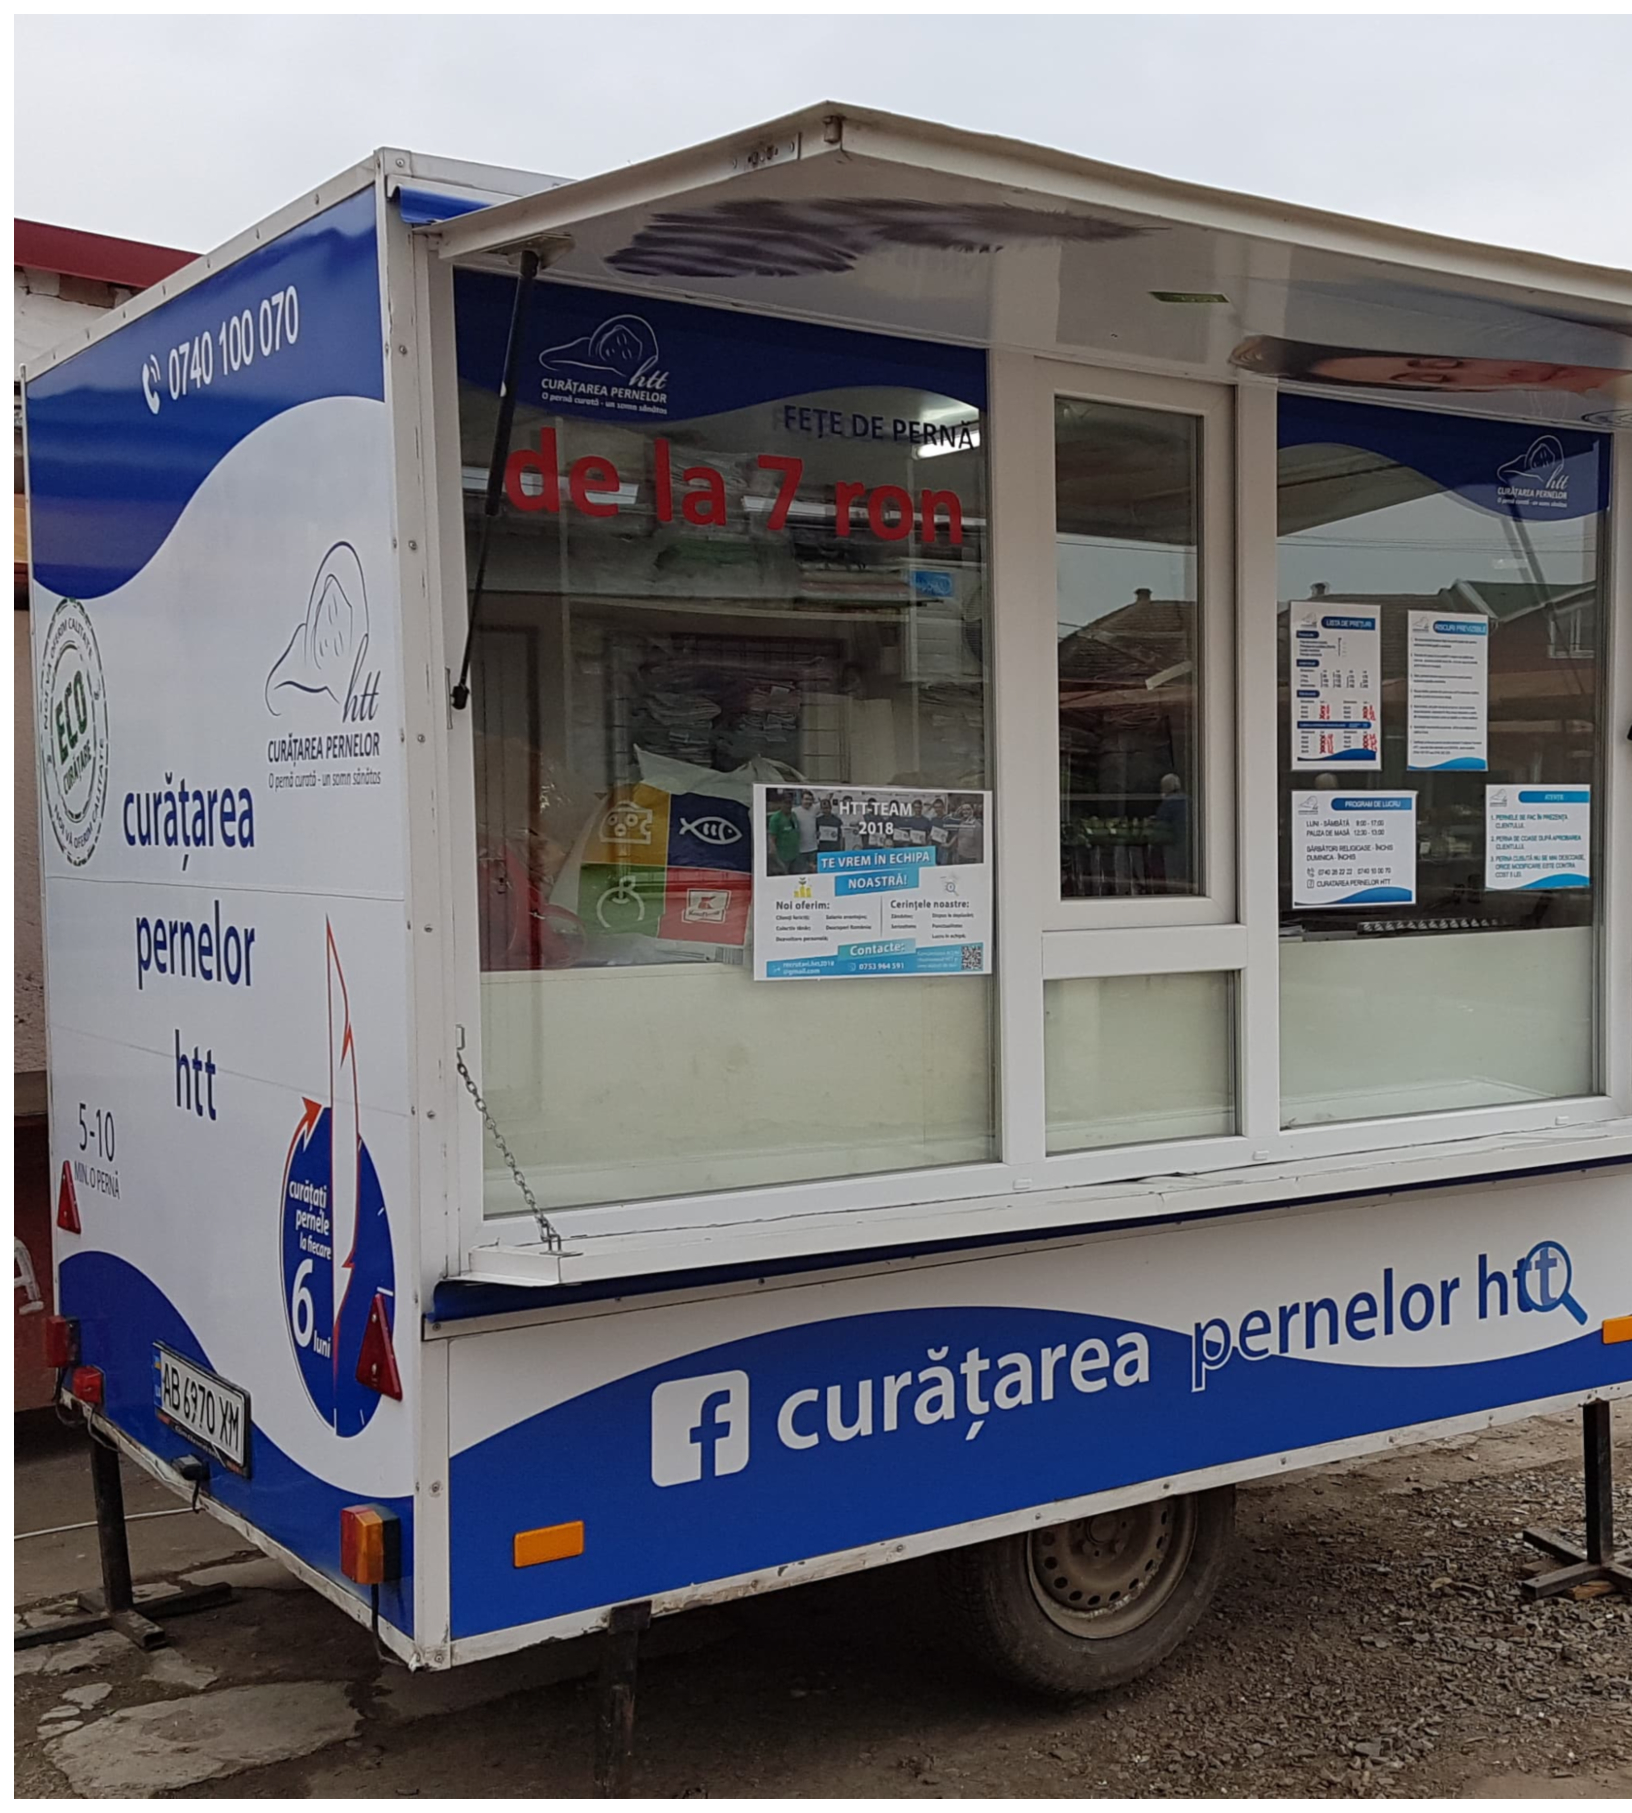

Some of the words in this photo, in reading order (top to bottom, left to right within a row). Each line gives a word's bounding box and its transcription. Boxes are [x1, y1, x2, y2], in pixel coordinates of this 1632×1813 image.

[168, 330, 213, 400] 0740
[219, 309, 254, 376] 100
[259, 285, 299, 357] 070
[629, 357, 670, 390] htt
[541, 377, 608, 397] CURĂȚAREA
[610, 387, 667, 404] PERNELOR
[784, 404, 844, 439] FEȚE
[854, 415, 883, 439] DE
[893, 417, 976, 451] PERNĂ
[504, 426, 621, 518] de
[654, 436, 727, 527] la
[756, 453, 804, 532] 7
[834, 479, 964, 546] ron
[1545, 464, 1569, 490] htt
[1535, 489, 1568, 500] PERNELOR
[342, 640, 381, 722] htt
[55, 670, 88, 766] ECO
[268, 732, 323, 767] CURĂȚAREA
[326, 731, 380, 759] PERNELOR
[62, 738, 92, 796] CURĂȚARE
[268, 772, 274, 788] O
[275, 771, 294, 793] pernă
[295, 769, 317, 788] curată
[322, 773, 331, 786] un
[332, 772, 352, 786] somn
[123, 772, 255, 871] curățarea
[839, 801, 912, 816] HTT-TEAM
[858, 821, 894, 835] 2018
[821, 857, 836, 869] TE
[838, 855, 872, 868] VREM
[874, 853, 886, 865] ÎN
[889, 851, 930, 864] ECHIPA
[1339, 844, 1371, 852] RELIGIOASE
[848, 873, 908, 889] NOASTRĂ!
[1349, 879, 1379, 887] PERNELOR
[776, 901, 794, 911] Noi
[794, 900, 830, 911] oferim:
[890, 899, 932, 911] Cerințele
[932, 899, 970, 909] noastre:
[136, 899, 256, 990] pernelor
[849, 941, 906, 956] Contacte:
[175, 1027, 217, 1121] htt
[79, 1102, 115, 1162] 5-10
[96, 1169, 120, 1200] PERNĂ
[295, 1209, 330, 1236] pernele
[299, 1231, 307, 1251] la
[307, 1234, 332, 1260] fiecare
[292, 1258, 314, 1348] 6
[313, 1329, 332, 1359] luni
[776, 1331, 1151, 1442] curățarea
[1191, 1266, 1460, 1393] pernelor
[1477, 1246, 1558, 1320] htt
[163, 1361, 181, 1411] AB
[219, 1395, 240, 1453] XM
